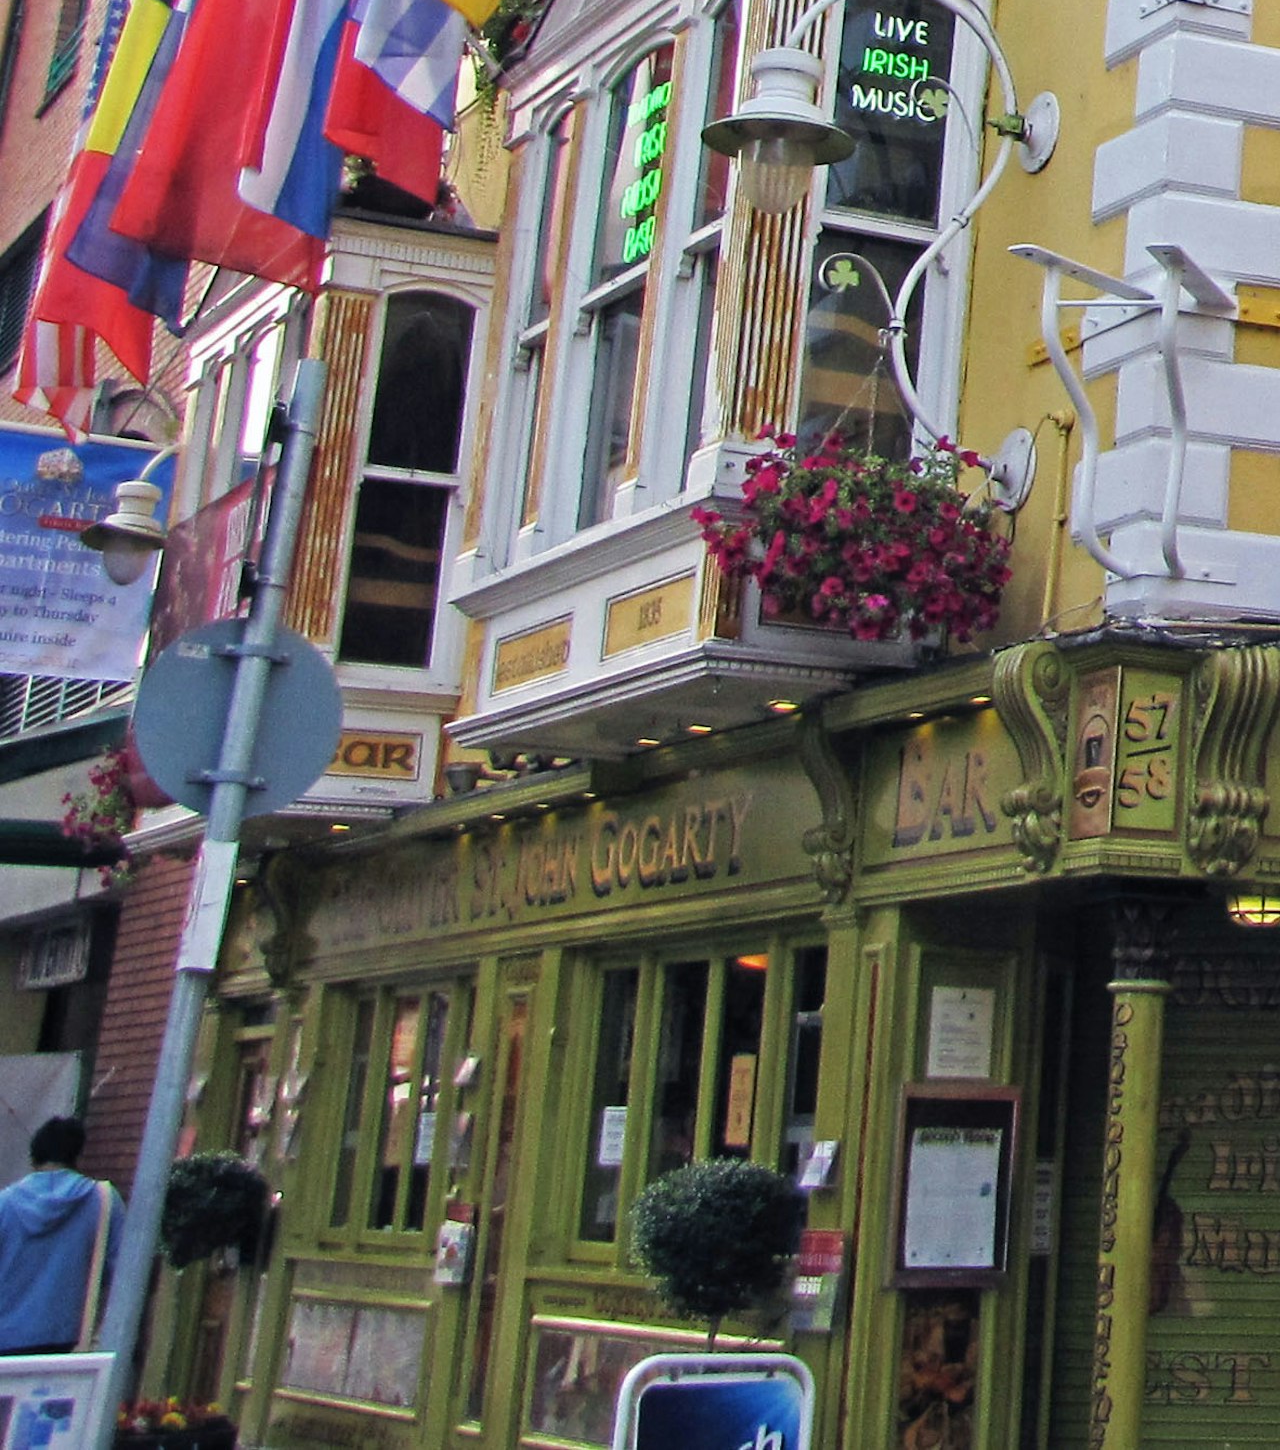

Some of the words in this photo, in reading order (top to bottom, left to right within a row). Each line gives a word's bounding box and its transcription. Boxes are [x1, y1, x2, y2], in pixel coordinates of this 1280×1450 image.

[874, 12, 928, 45] LIVE
[862, 50, 929, 82] IRISH
[851, 83, 939, 123] MUSIC
[61, 587, 106, 606] Sleeps
[13, 606, 28, 618] to
[34, 605, 99, 625] Thursday
[34, 630, 77, 647] inside
[1125, 692, 1175, 742] 57
[892, 746, 997, 848] BAR
[1117, 756, 1172, 810] 58
[588, 790, 756, 898] GOGARTY
